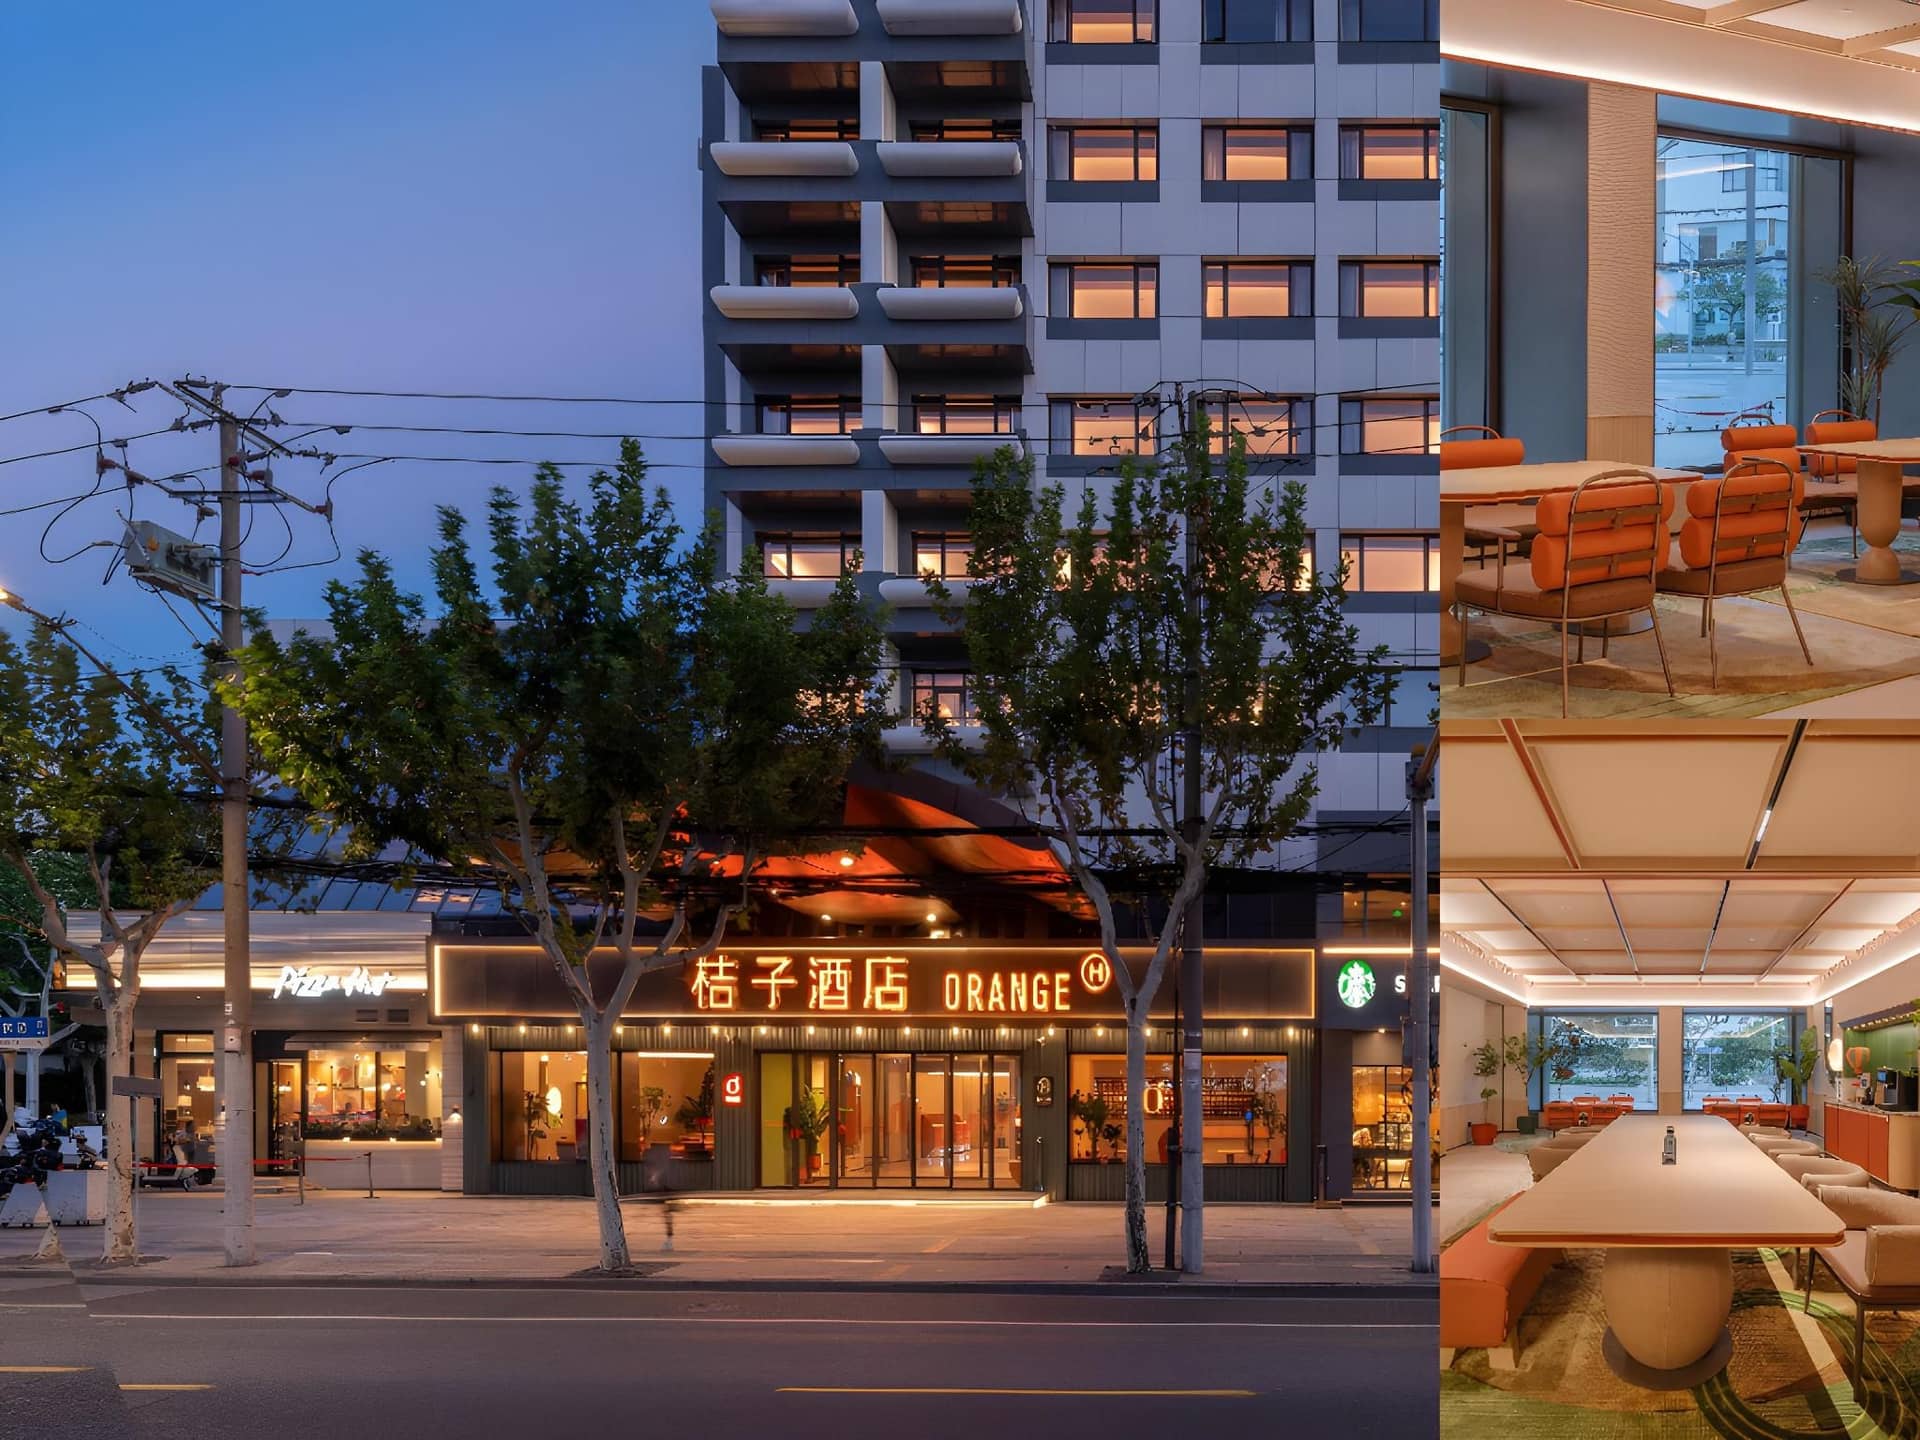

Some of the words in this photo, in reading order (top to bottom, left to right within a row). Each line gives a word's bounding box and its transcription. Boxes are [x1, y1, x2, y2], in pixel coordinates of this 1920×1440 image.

[273, 966, 341, 999] Pizza
[344, 965, 398, 996] Hut
[691, 955, 908, 1011] 桔子酒店
[945, 972, 1071, 1012] ORANGE
